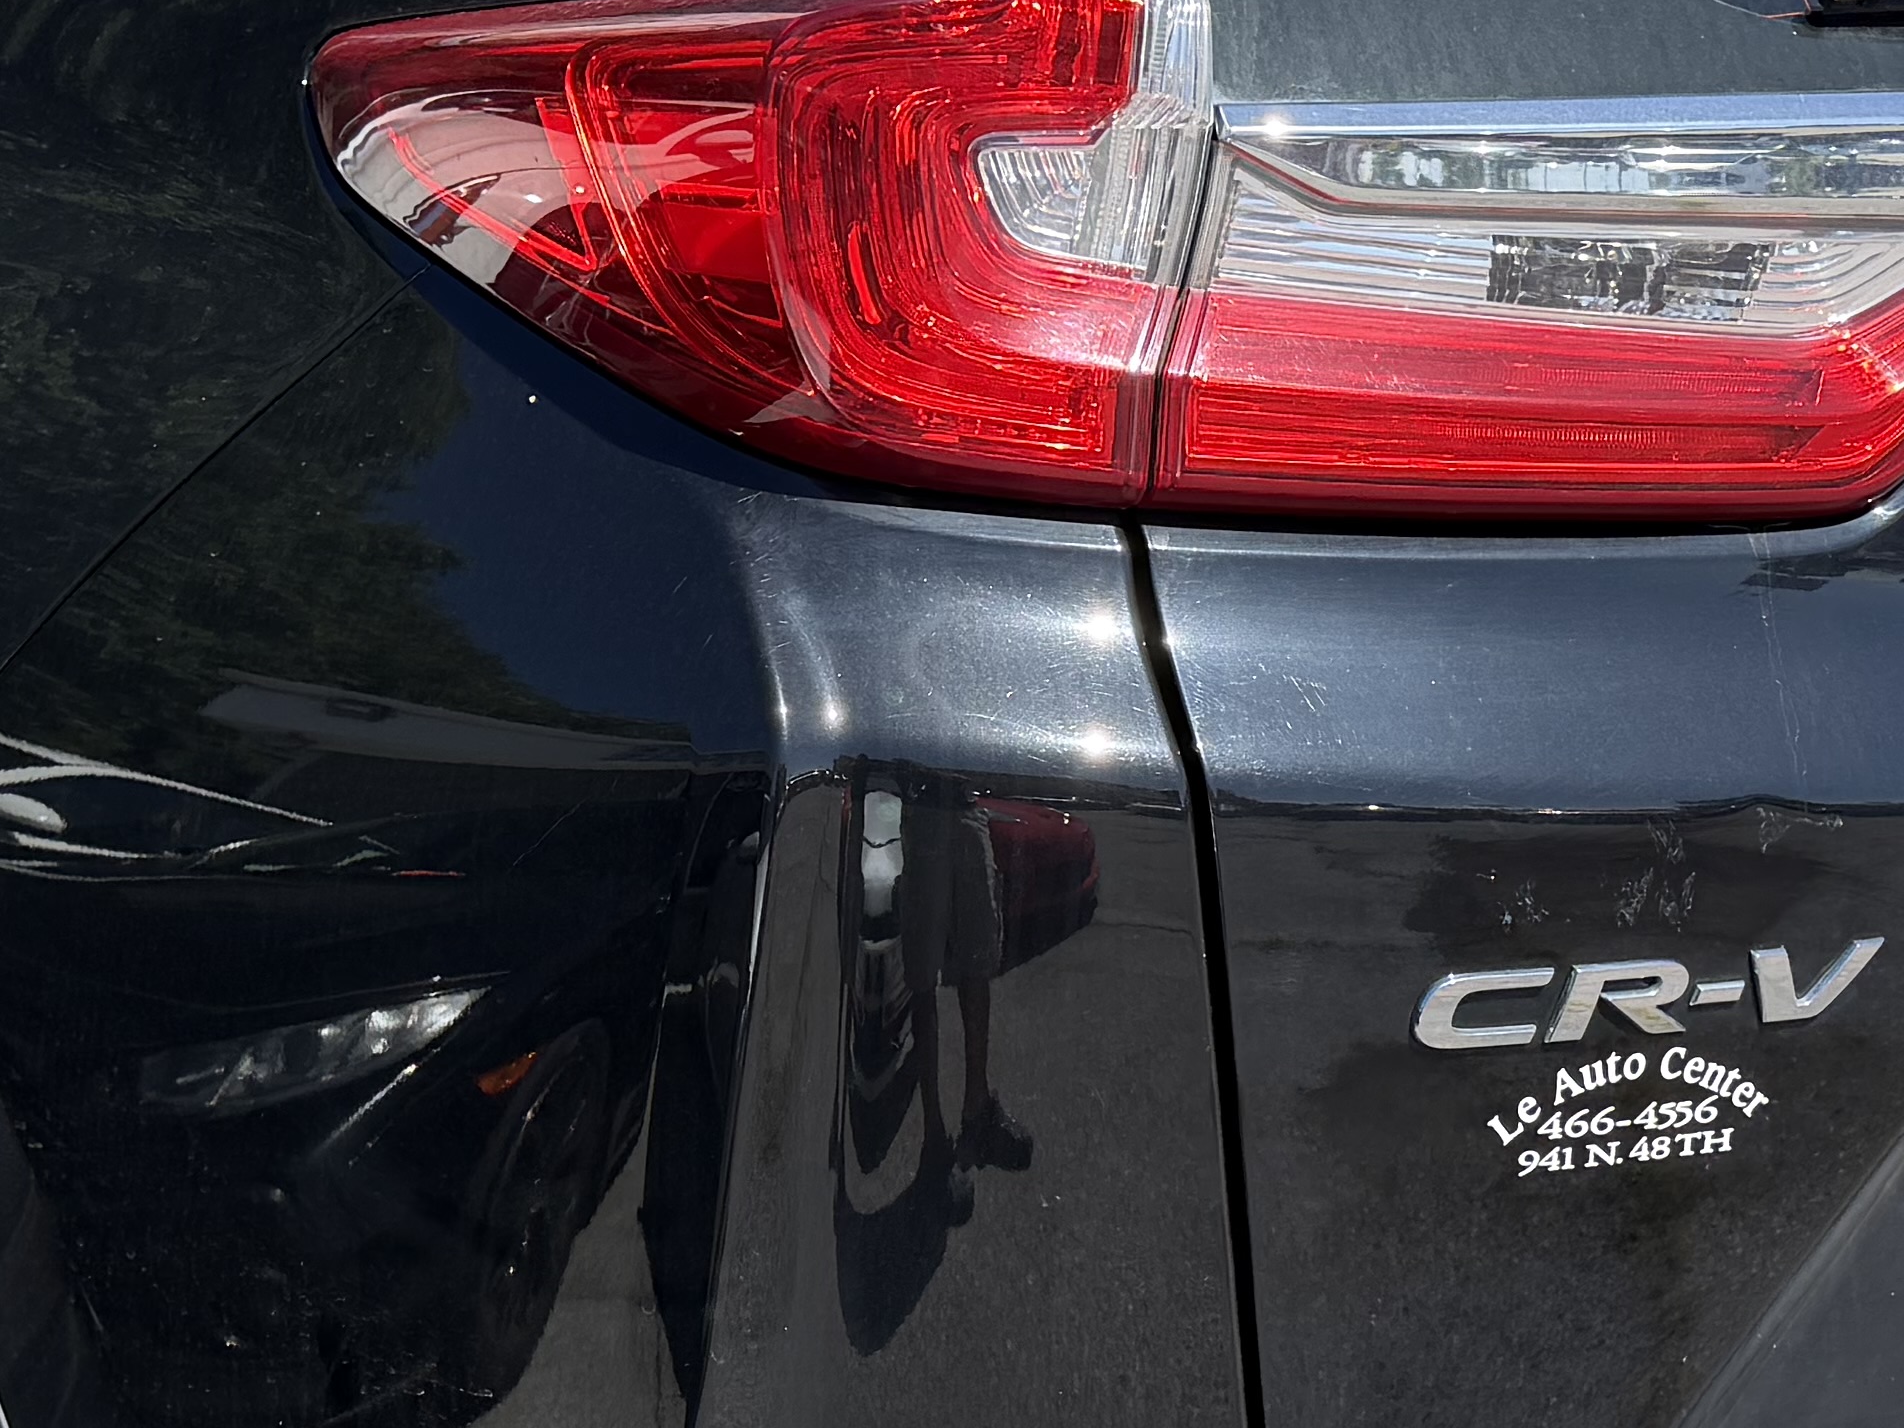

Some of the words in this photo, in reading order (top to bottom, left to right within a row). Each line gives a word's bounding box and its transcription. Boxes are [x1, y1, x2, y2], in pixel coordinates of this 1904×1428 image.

[1410, 935, 1885, 1050] CR-V
[1487, 1095, 1542, 1147] Le
[1553, 1051, 1647, 1107] Auto
[1660, 1046, 1770, 1119] Center
[1536, 1094, 1719, 1140] 466-4556
[1517, 1145, 1576, 1178] 941
[1583, 1140, 1624, 1169] N.
[1629, 1127, 1735, 1162] 48TH
